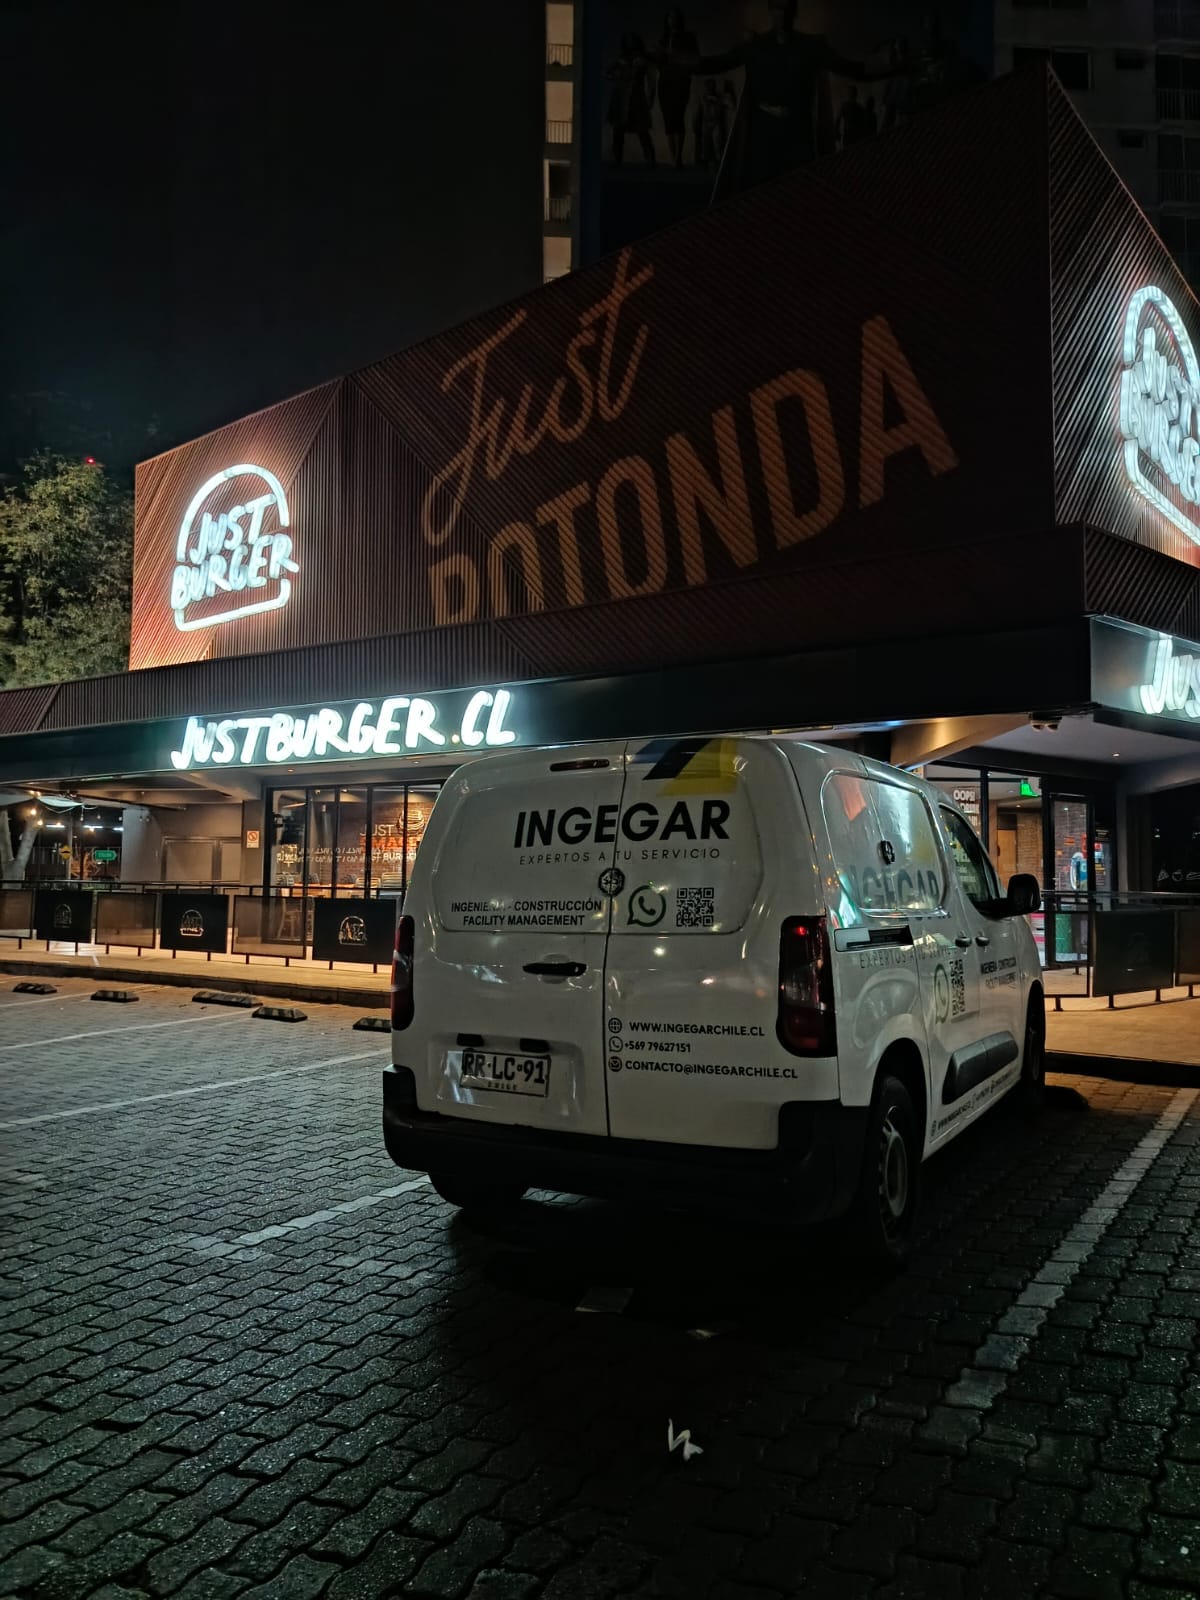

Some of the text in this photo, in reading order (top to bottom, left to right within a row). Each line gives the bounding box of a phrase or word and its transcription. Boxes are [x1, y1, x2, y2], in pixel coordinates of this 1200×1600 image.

[421, 246, 656, 547] Just
[189, 493, 277, 565] JUST
[171, 533, 300, 610] BURGER
[514, 800, 731, 848] INGEGAR
[519, 848, 720, 865] EXPERTOS A TU SERVICIO
[514, 897, 602, 912] CONSTRUCCIÓN
[463, 914, 585, 926] FACILITY MANAGEMENT
[629, 1022, 765, 1037] WWW.INGEGARCHILE.CL
[648, 1041, 691, 1053] 79627151
[625, 1060, 798, 1079] CONTACTO@INGEGARCHILE.CL
